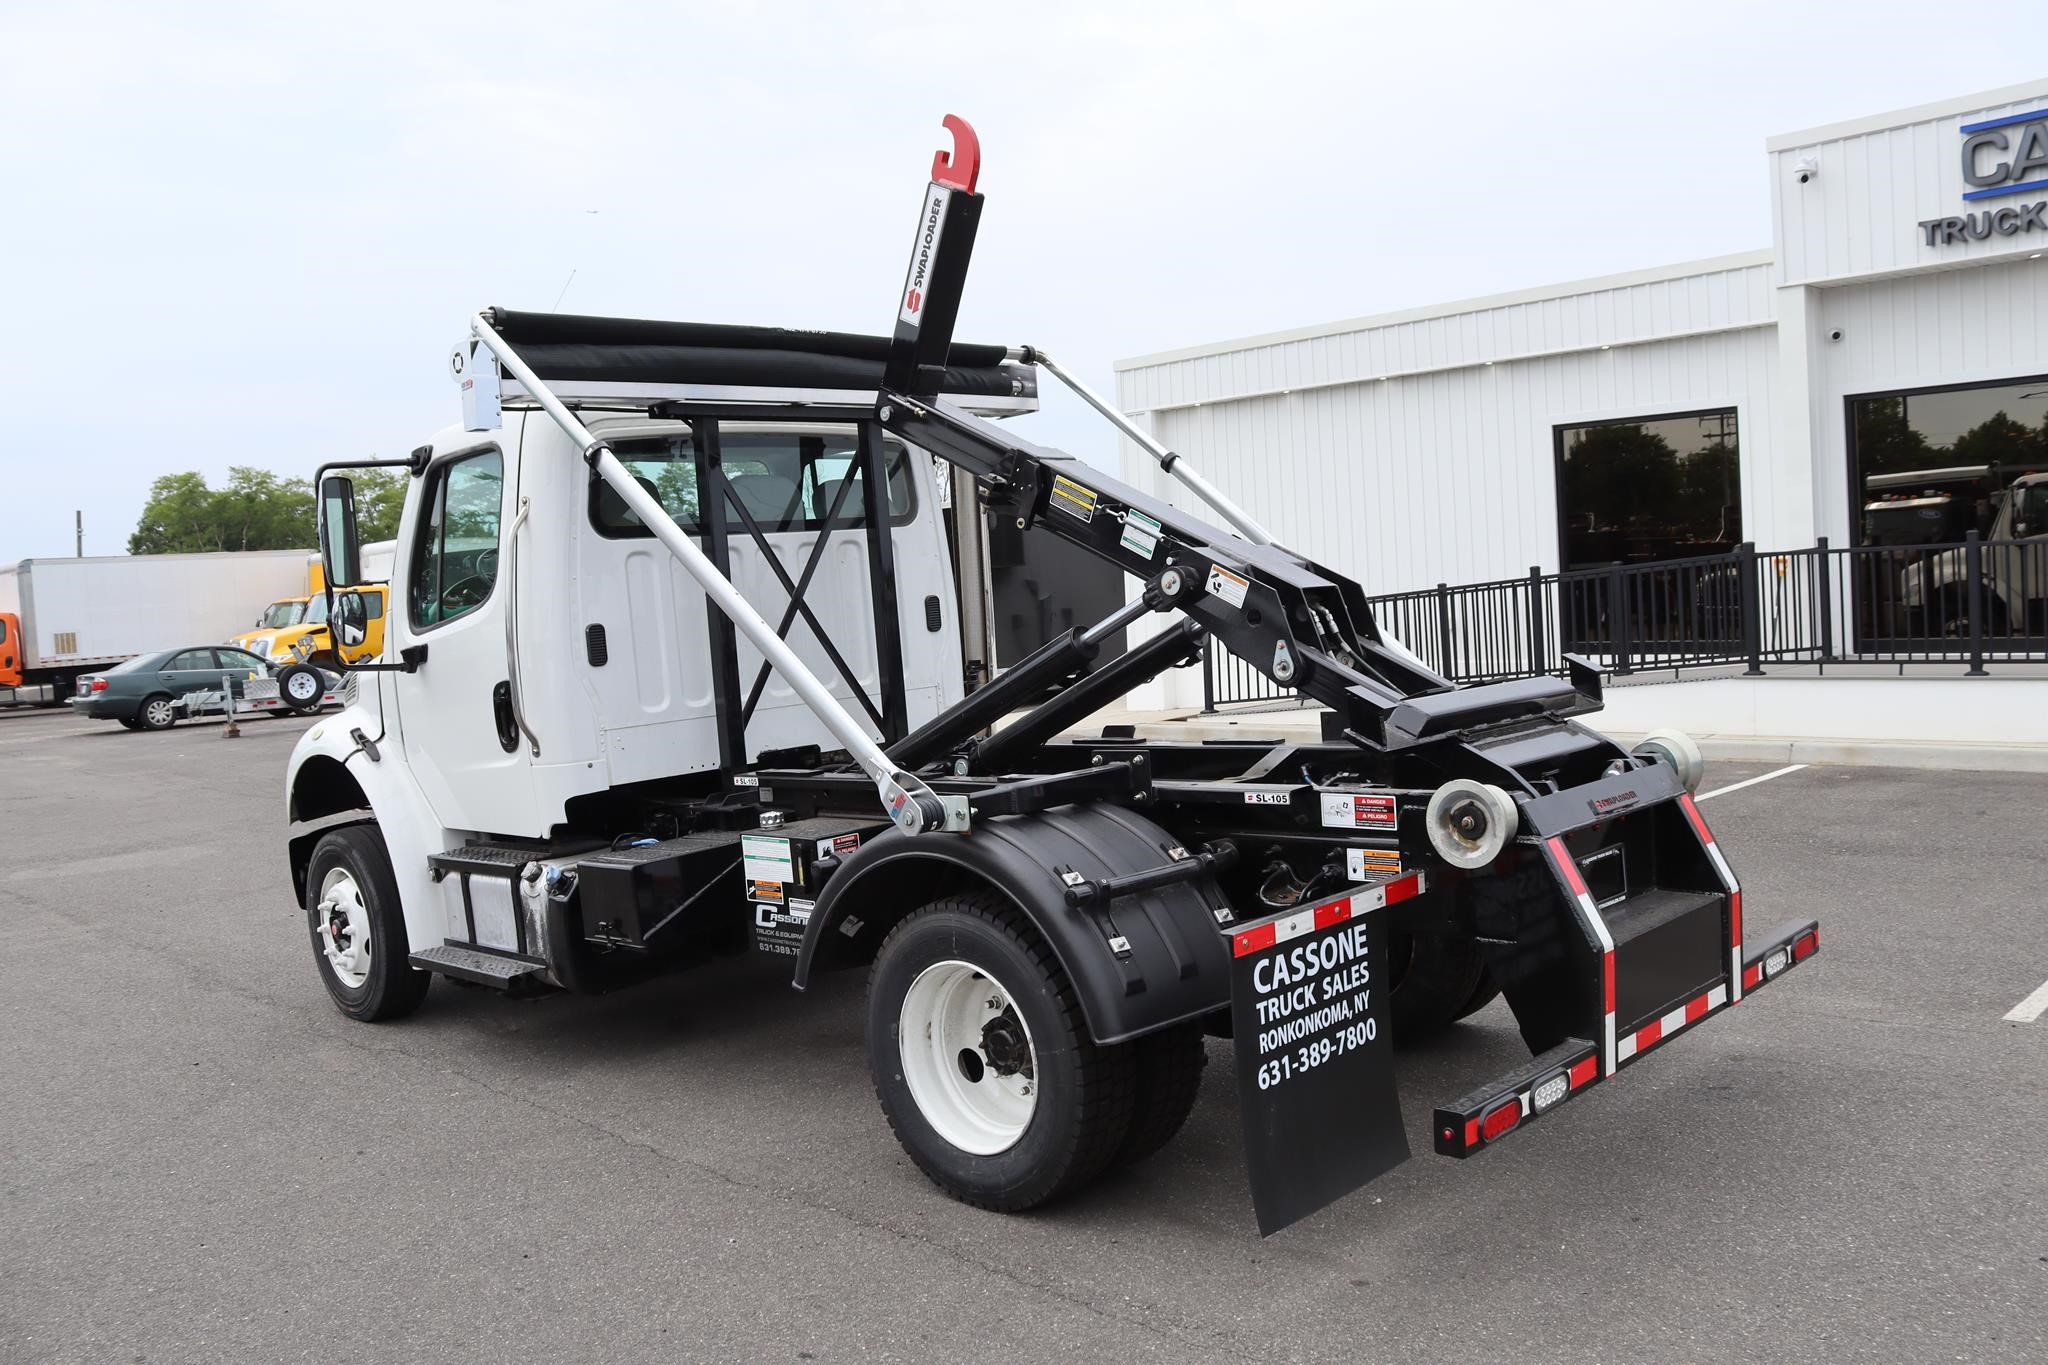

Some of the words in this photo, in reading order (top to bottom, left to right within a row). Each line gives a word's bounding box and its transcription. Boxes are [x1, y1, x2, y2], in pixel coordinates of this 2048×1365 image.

[914, 197, 942, 288] SWAPLOADER
[1918, 201, 2048, 248] TRUCK
[1256, 794, 1288, 804] SL-105
[756, 928, 775, 936] TRUCK
[1253, 923, 1369, 994] CASSONE
[1255, 982, 1317, 1026] TRUCK
[1322, 961, 1370, 1000] SALES
[1258, 999, 1353, 1055] RONKONKOMA,
[1354, 989, 1371, 1013] NY
[1257, 1017, 1377, 1091] 631-389-7800
